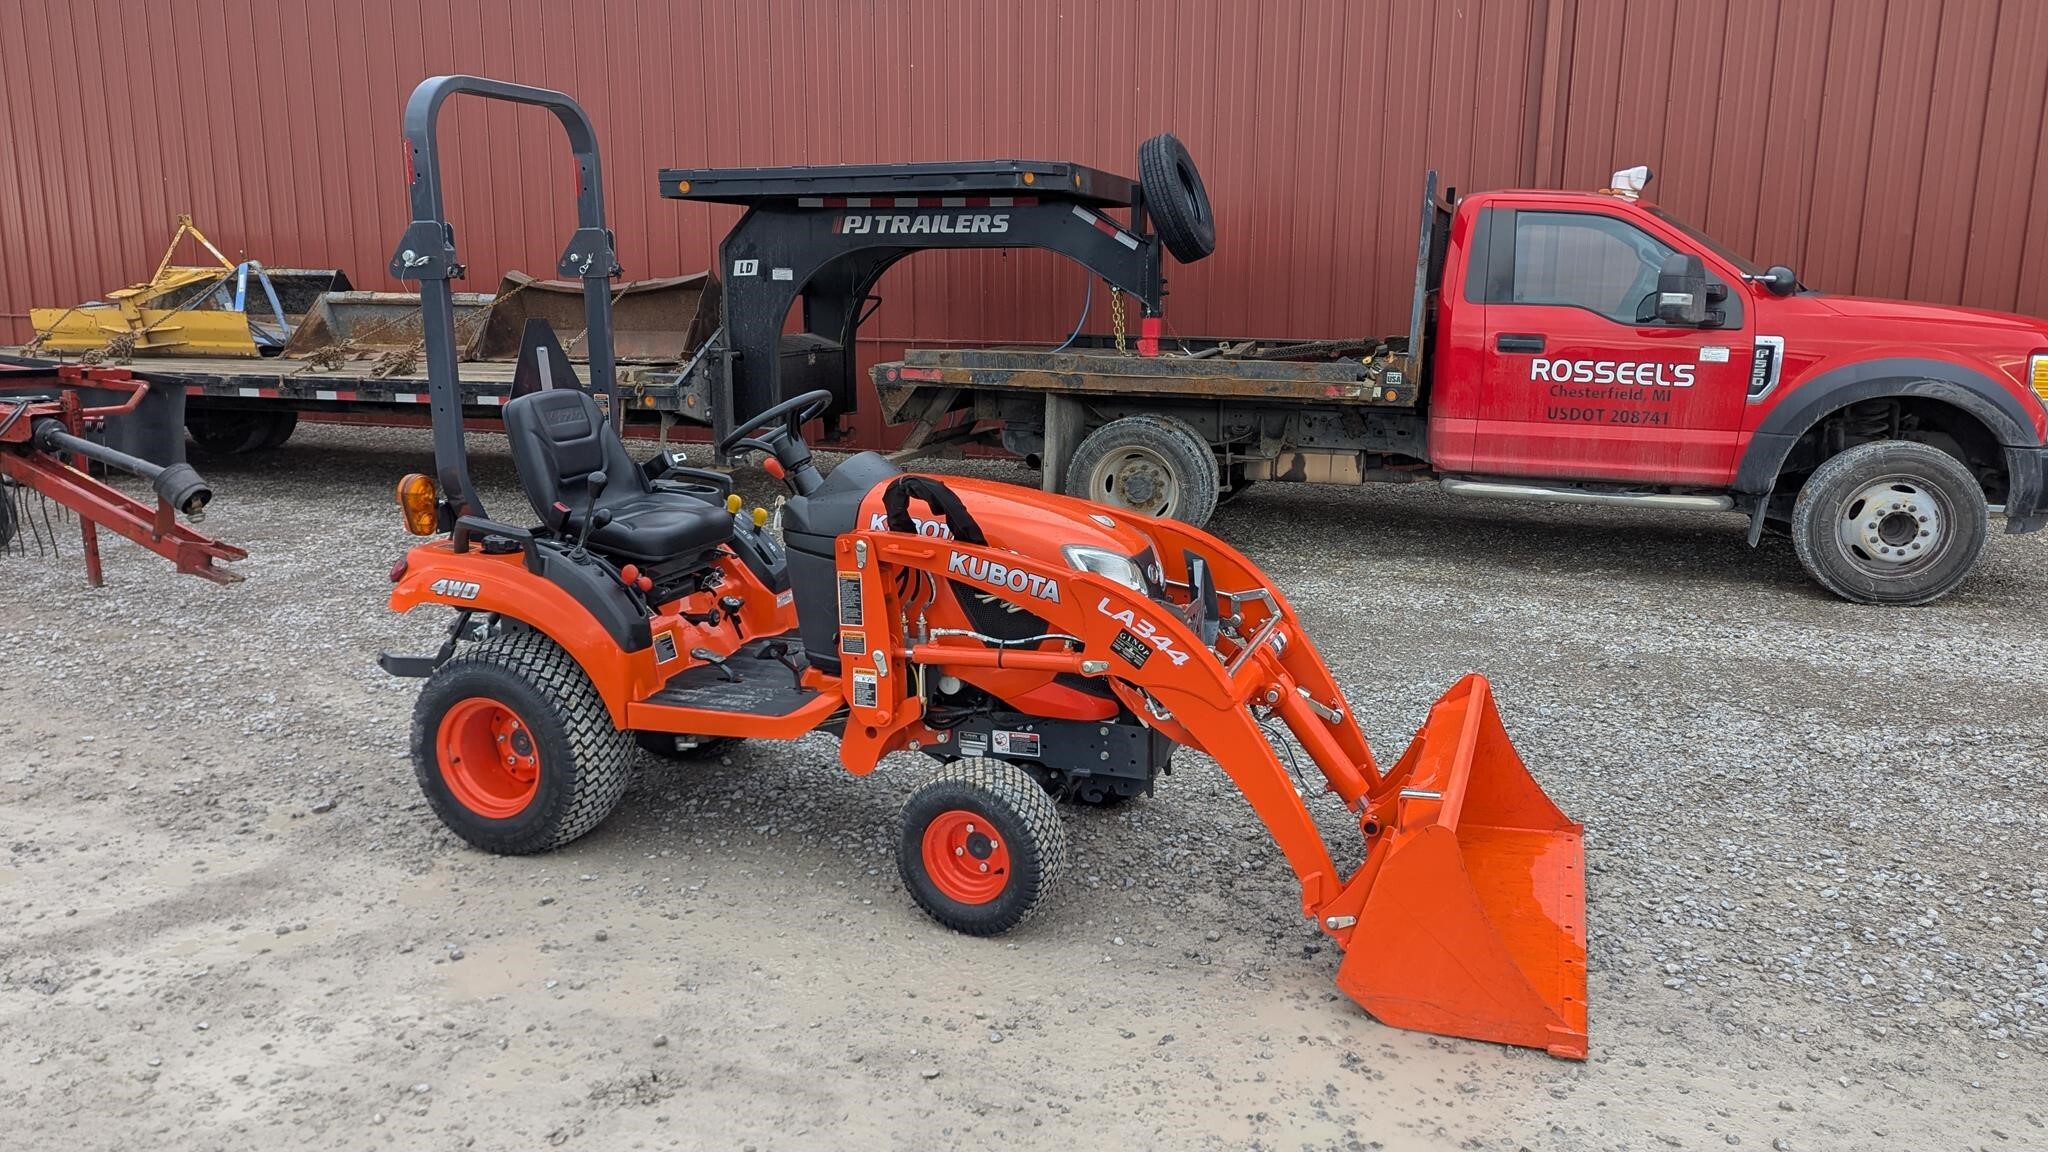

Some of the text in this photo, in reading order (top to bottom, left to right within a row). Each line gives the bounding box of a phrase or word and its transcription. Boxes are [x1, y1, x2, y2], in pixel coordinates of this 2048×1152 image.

[842, 214, 1010, 234] PJ TRAILERS
[740, 262, 753, 274] LD
[1530, 358, 1696, 388] ROSSEEL'S
[1550, 384, 1672, 403] Chesterfield, MI
[1547, 406, 1670, 425] USDOT 208741
[948, 550, 1061, 604] KUBOTA
[430, 578, 481, 600] 4WD
[1097, 597, 1190, 666] LA344
